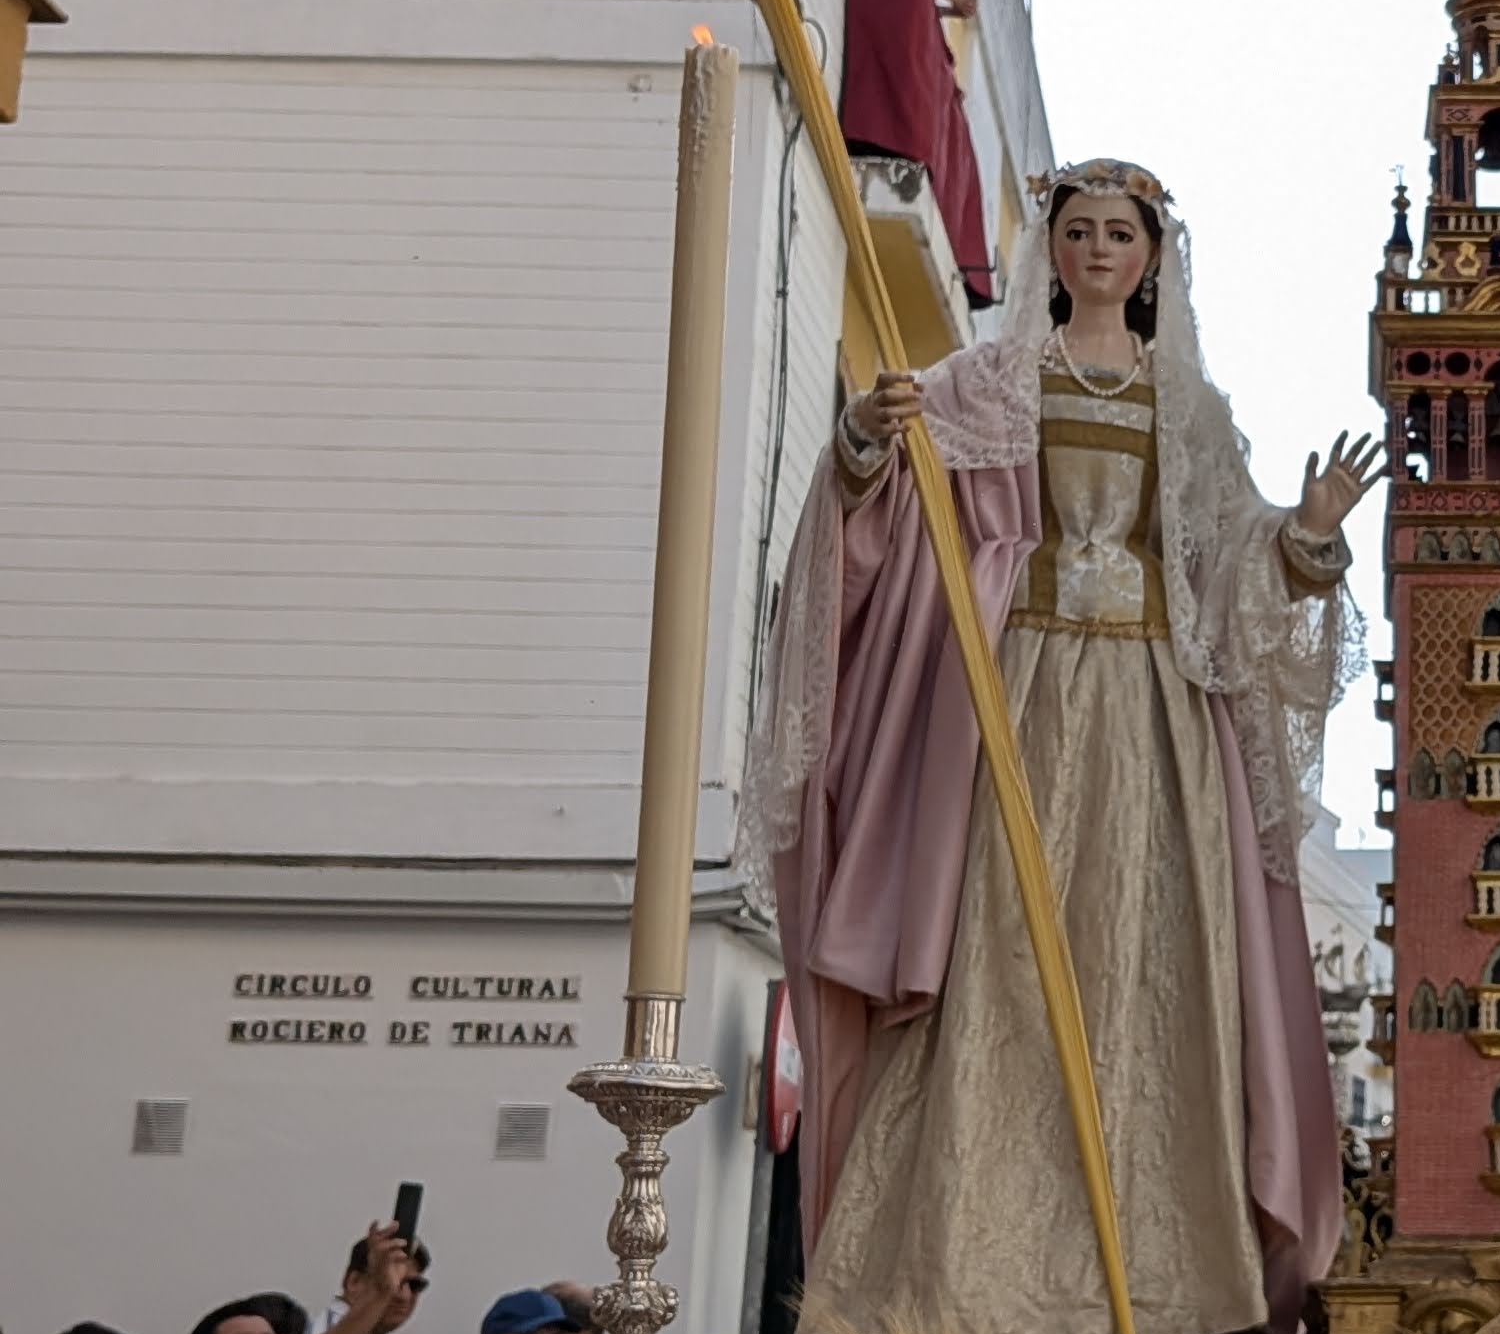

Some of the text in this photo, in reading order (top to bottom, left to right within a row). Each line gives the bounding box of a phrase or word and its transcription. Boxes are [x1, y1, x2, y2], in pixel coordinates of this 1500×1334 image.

[234, 974, 580, 999] CIRCULO CULTURAL
[230, 1020, 576, 1045] ROCIERO DE TRIANA
